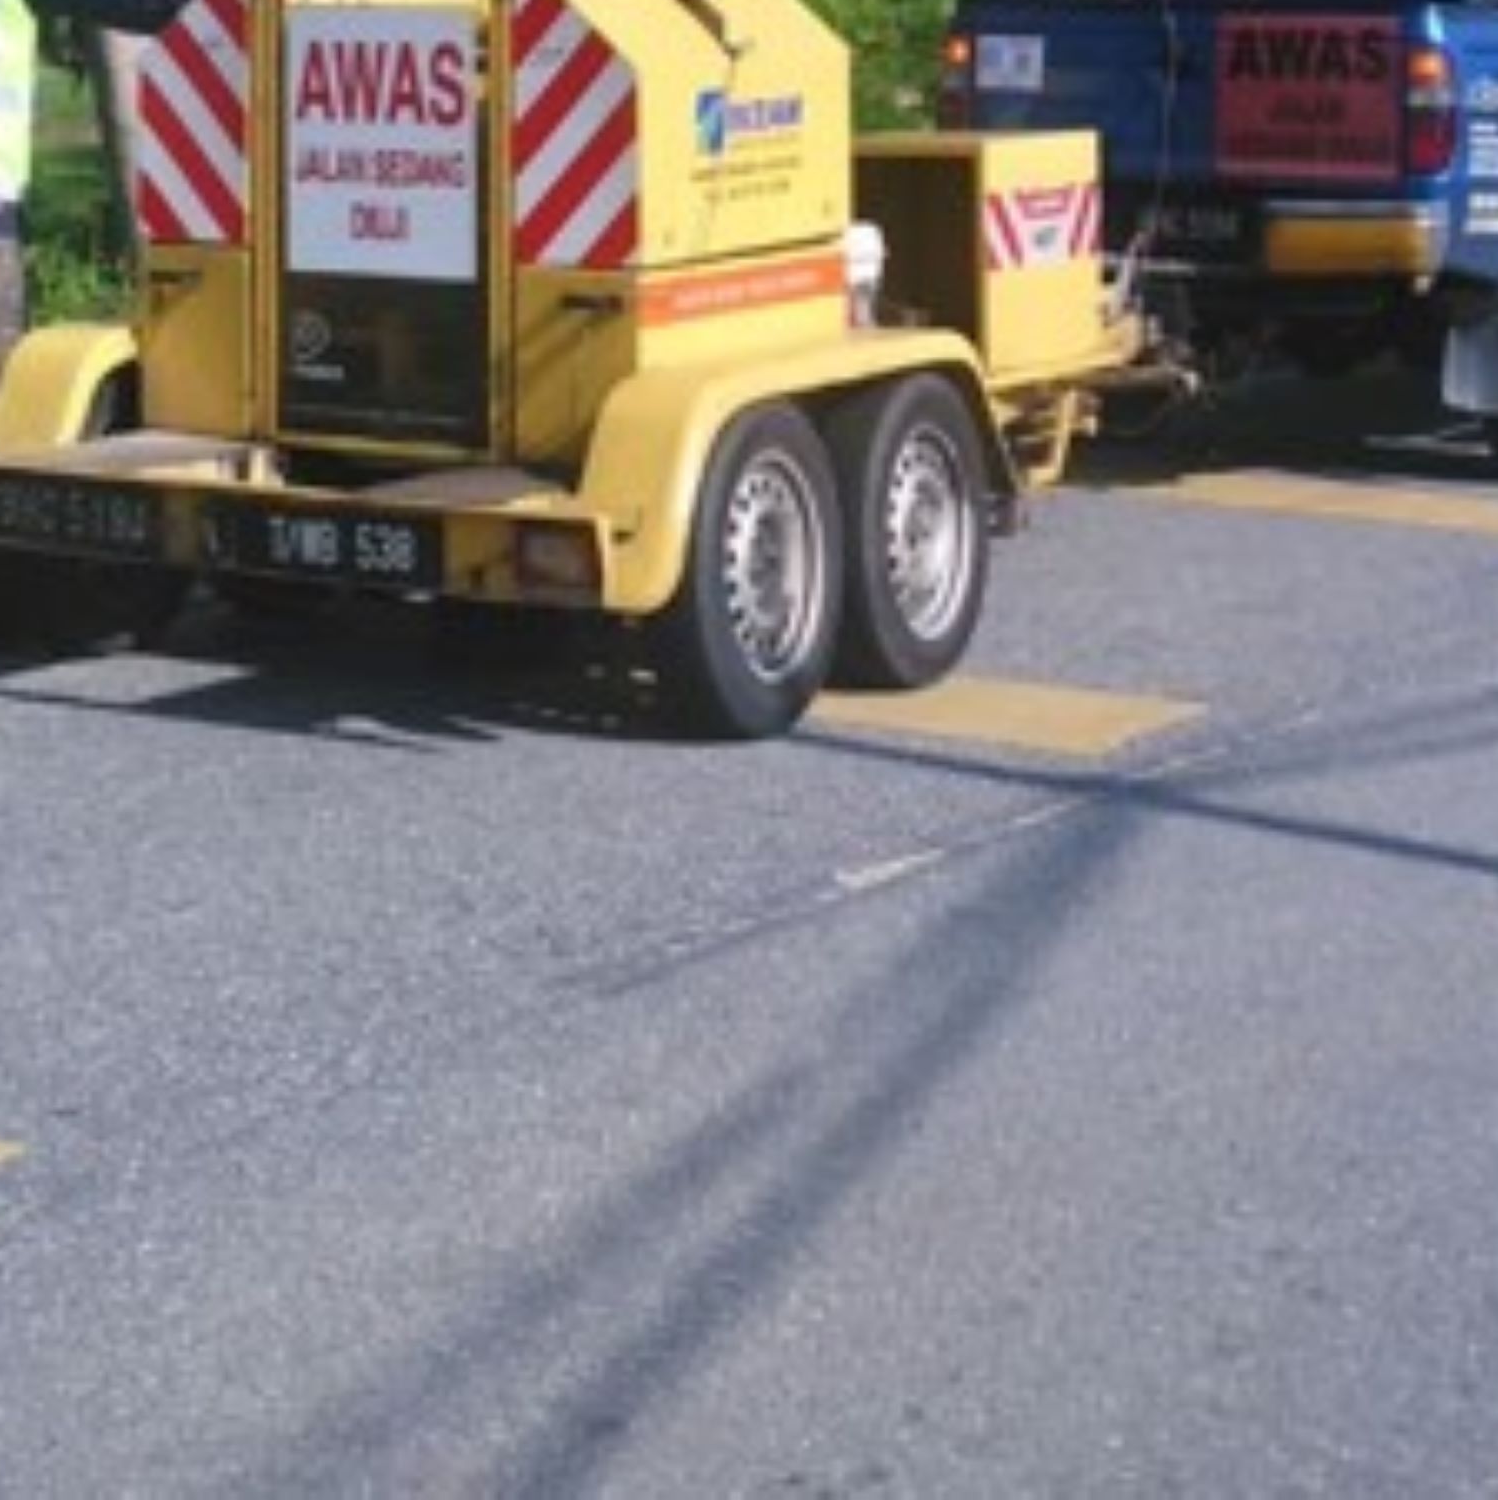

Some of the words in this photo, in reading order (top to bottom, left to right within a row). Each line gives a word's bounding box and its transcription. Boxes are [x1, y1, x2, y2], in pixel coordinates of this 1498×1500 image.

[1227, 28, 1389, 82] AWAS
[295, 40, 466, 126] AWAS
[296, 148, 364, 182] JALAN
[374, 149, 466, 188] SEDANG
